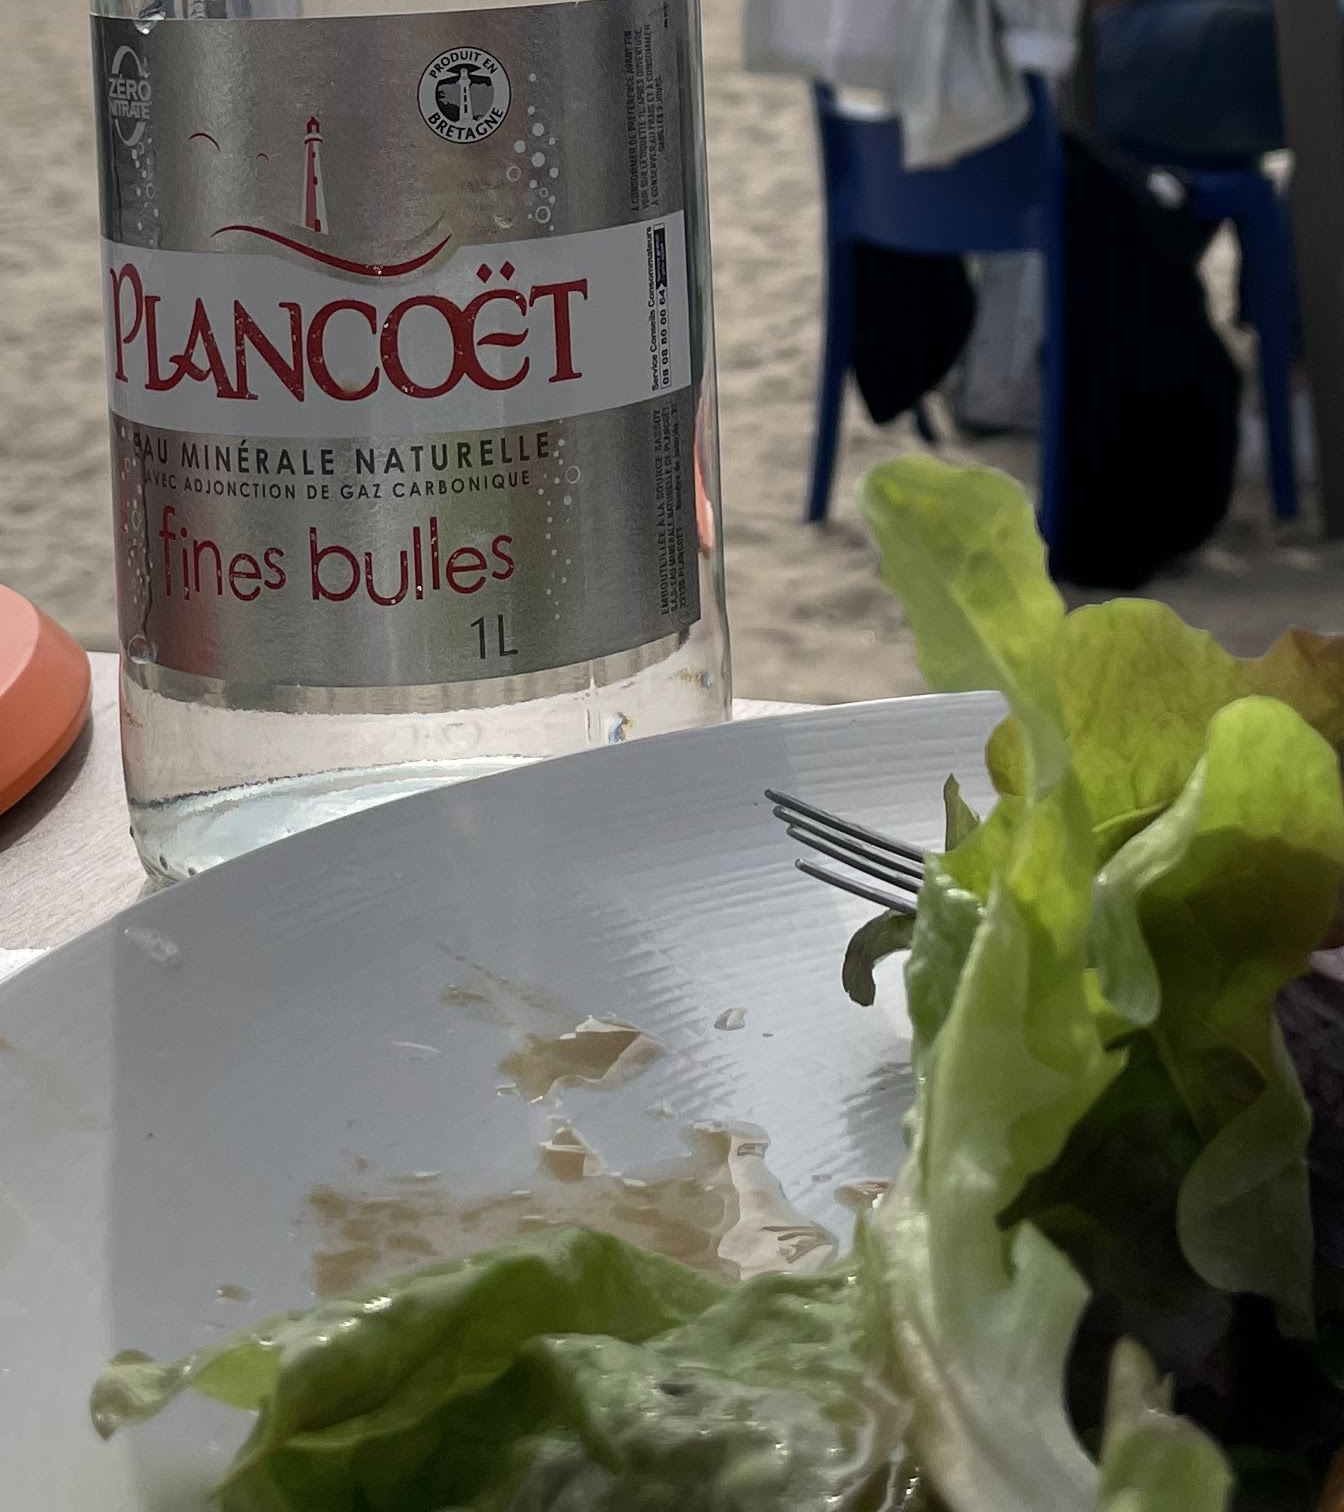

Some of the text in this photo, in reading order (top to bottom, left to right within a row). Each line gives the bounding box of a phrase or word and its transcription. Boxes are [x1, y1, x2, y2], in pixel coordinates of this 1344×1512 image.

[108, 73, 152, 101] ZÉRO
[429, 50, 498, 79] PRODUIT EN
[427, 107, 504, 140] BRETAGNE
[109, 260, 588, 402] PLANCOËT
[646, 226, 659, 391] Service Conseils Consommateurs
[133, 431, 550, 476] EAU MINÉRALE NATURELLE
[144, 468, 531, 501] AVEC ADJONCTION DE GAZ CARBONIQUE
[159, 504, 516, 607] fines bulles
[469, 613, 519, 660] 1L
